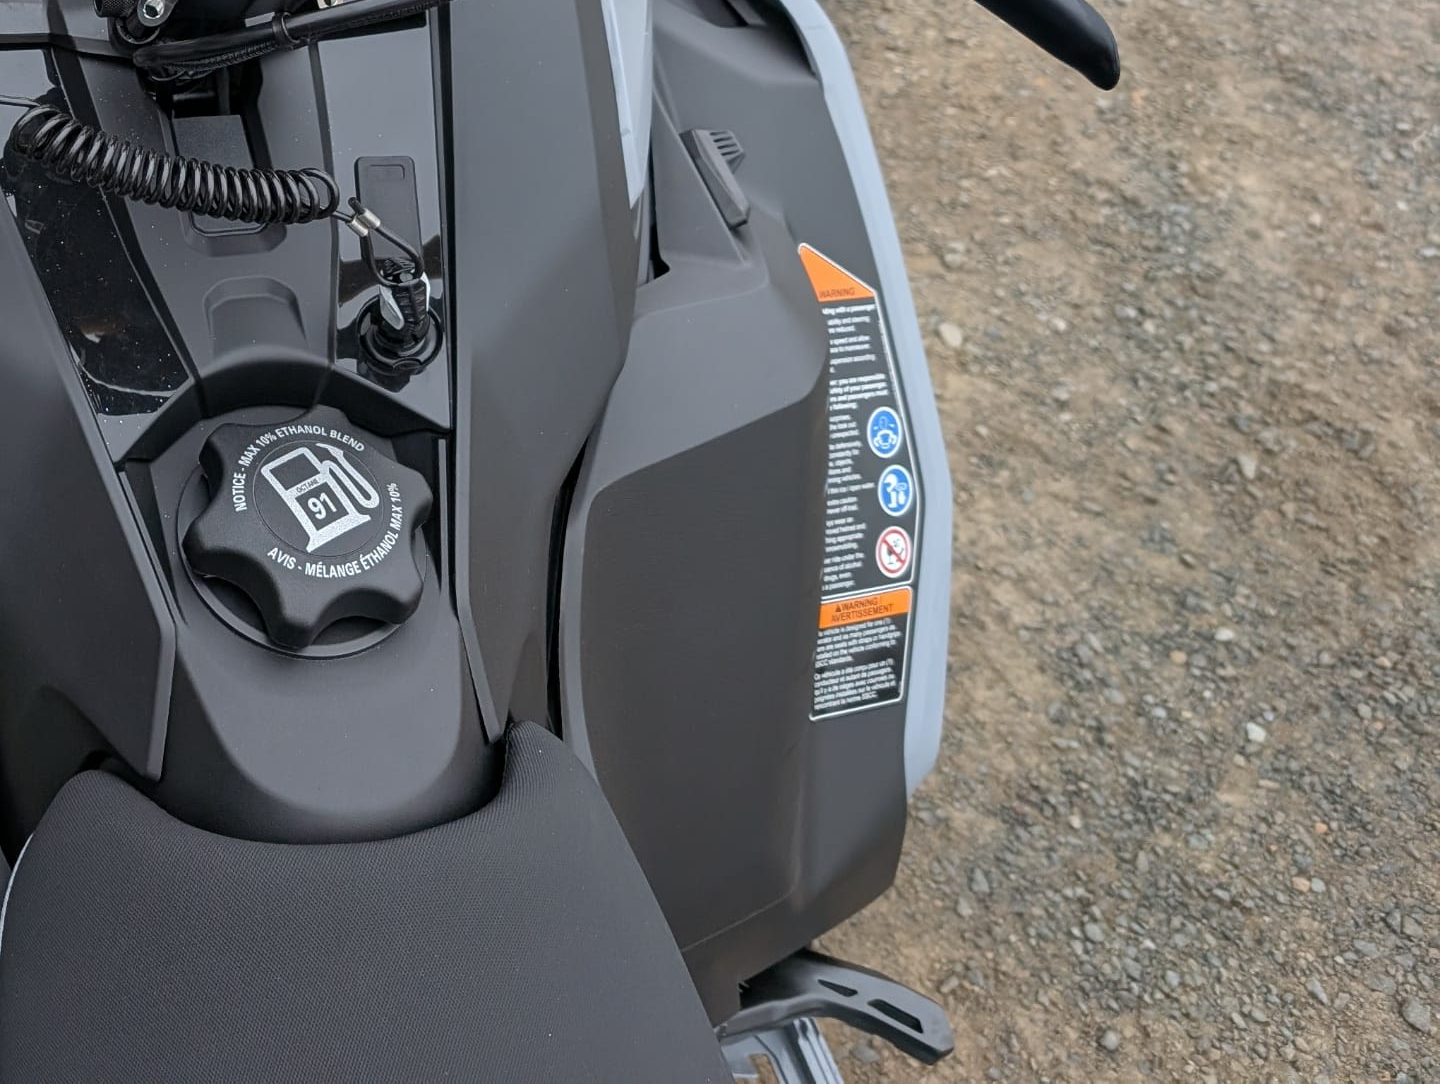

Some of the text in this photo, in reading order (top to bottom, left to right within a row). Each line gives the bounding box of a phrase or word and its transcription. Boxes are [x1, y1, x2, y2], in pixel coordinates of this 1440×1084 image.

[819, 287, 856, 299] WARNING
[256, 432, 278, 447] 10%
[275, 425, 328, 438] ETHANOL
[330, 429, 365, 452] BLEND
[238, 444, 261, 467] MAX
[232, 472, 247, 512] NOTICE
[296, 478, 320, 493] OCTANE
[386, 482, 402, 502] 10%
[307, 492, 337, 520] 91
[389, 504, 403, 531] MAX
[267, 547, 297, 570] AVIS
[360, 530, 399, 571] ÉTHANOL
[305, 561, 361, 579] MÉLANGE
[832, 604, 894, 623] AVERTISSEMENT
[841, 597, 878, 611] WARNING
